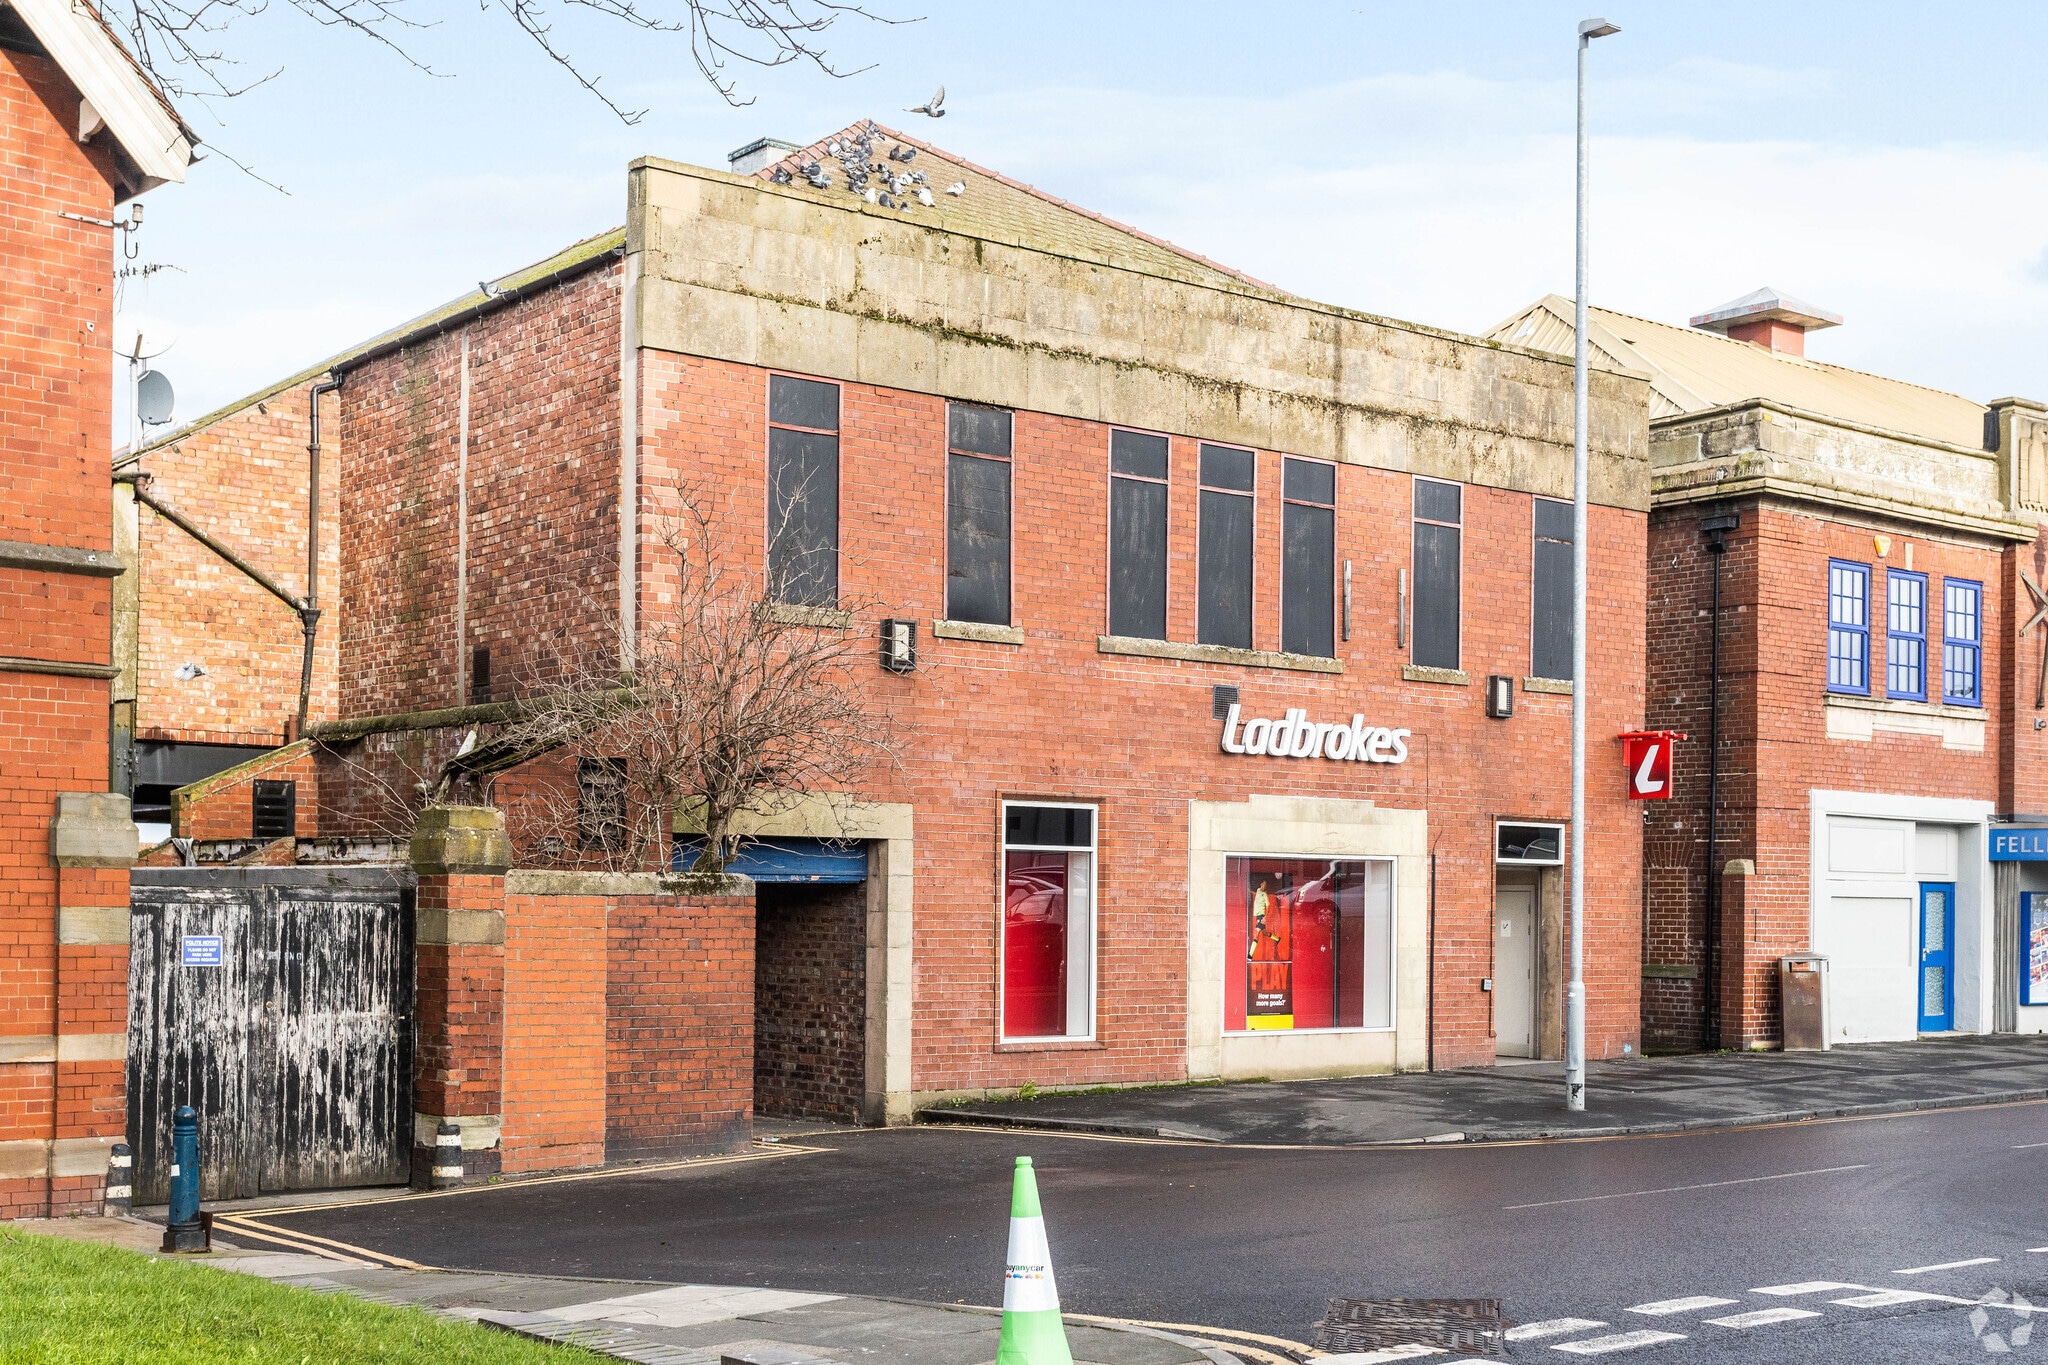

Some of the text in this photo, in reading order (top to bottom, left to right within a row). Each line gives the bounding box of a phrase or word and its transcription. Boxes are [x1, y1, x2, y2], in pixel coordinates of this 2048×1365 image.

[1222, 704, 1411, 763] Ladbrokes
[1635, 745, 1664, 794] L
[1997, 836, 2048, 853] FELL
[1251, 963, 1288, 990] PLAY
